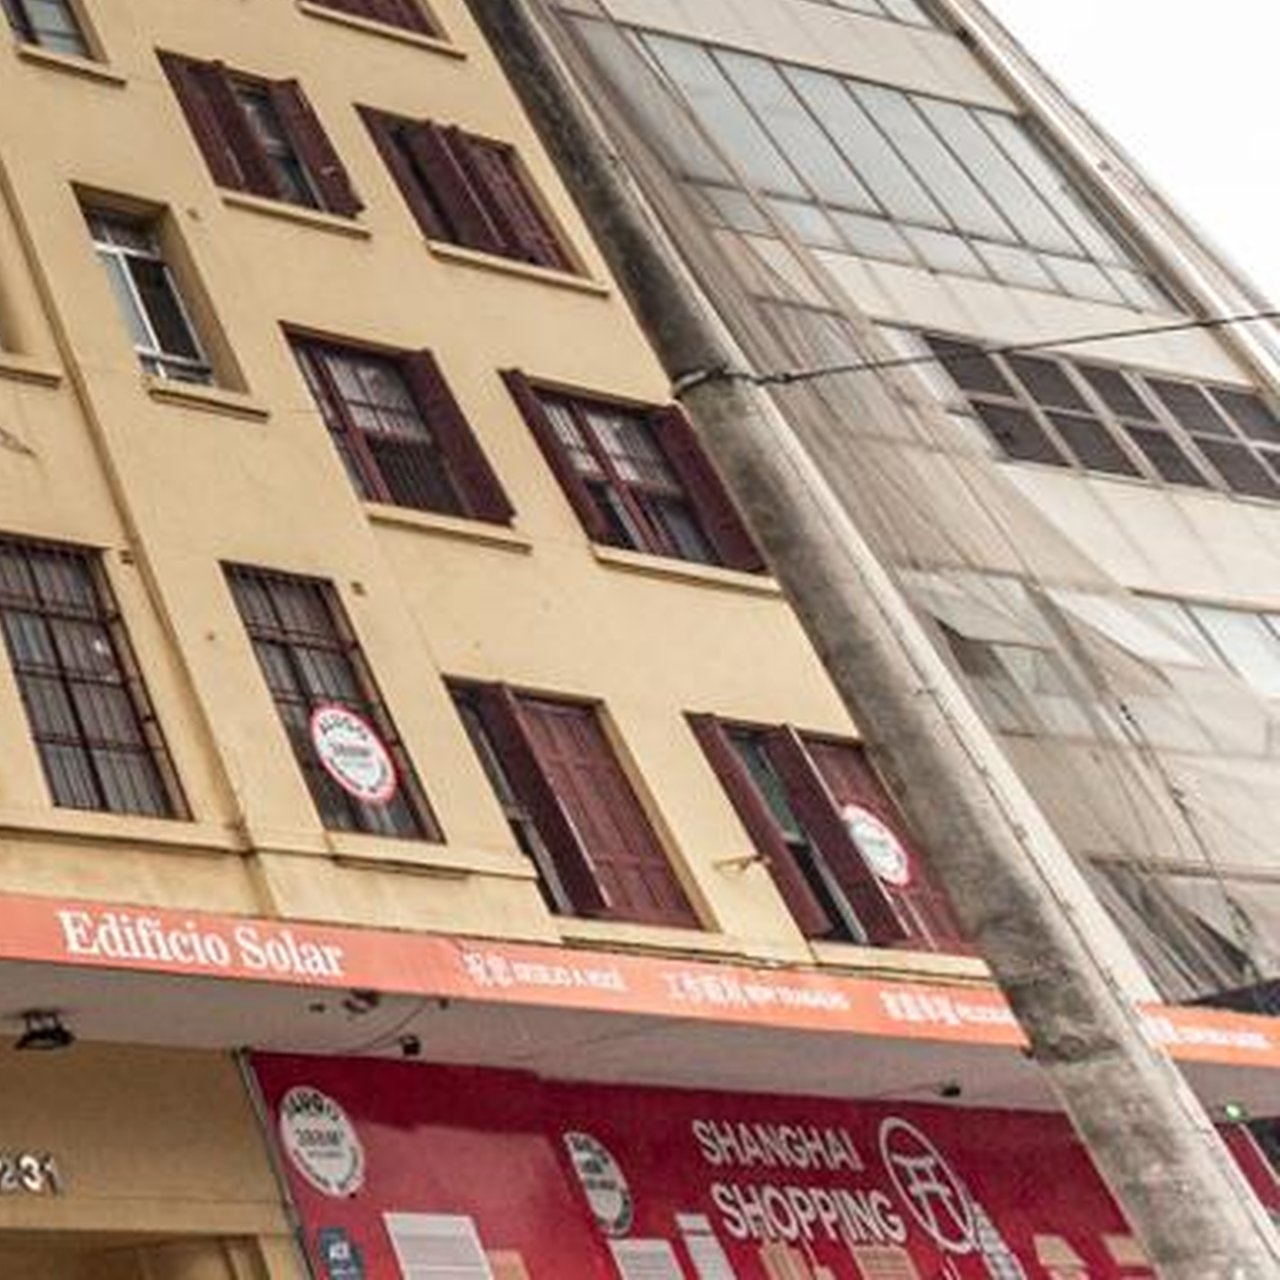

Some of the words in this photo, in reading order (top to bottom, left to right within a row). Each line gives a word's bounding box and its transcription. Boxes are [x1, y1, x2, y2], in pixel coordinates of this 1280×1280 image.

[235, 926, 343, 977] Solar
[692, 1119, 864, 1171] SHANGHAI
[710, 1182, 908, 1243] SHOPPING
